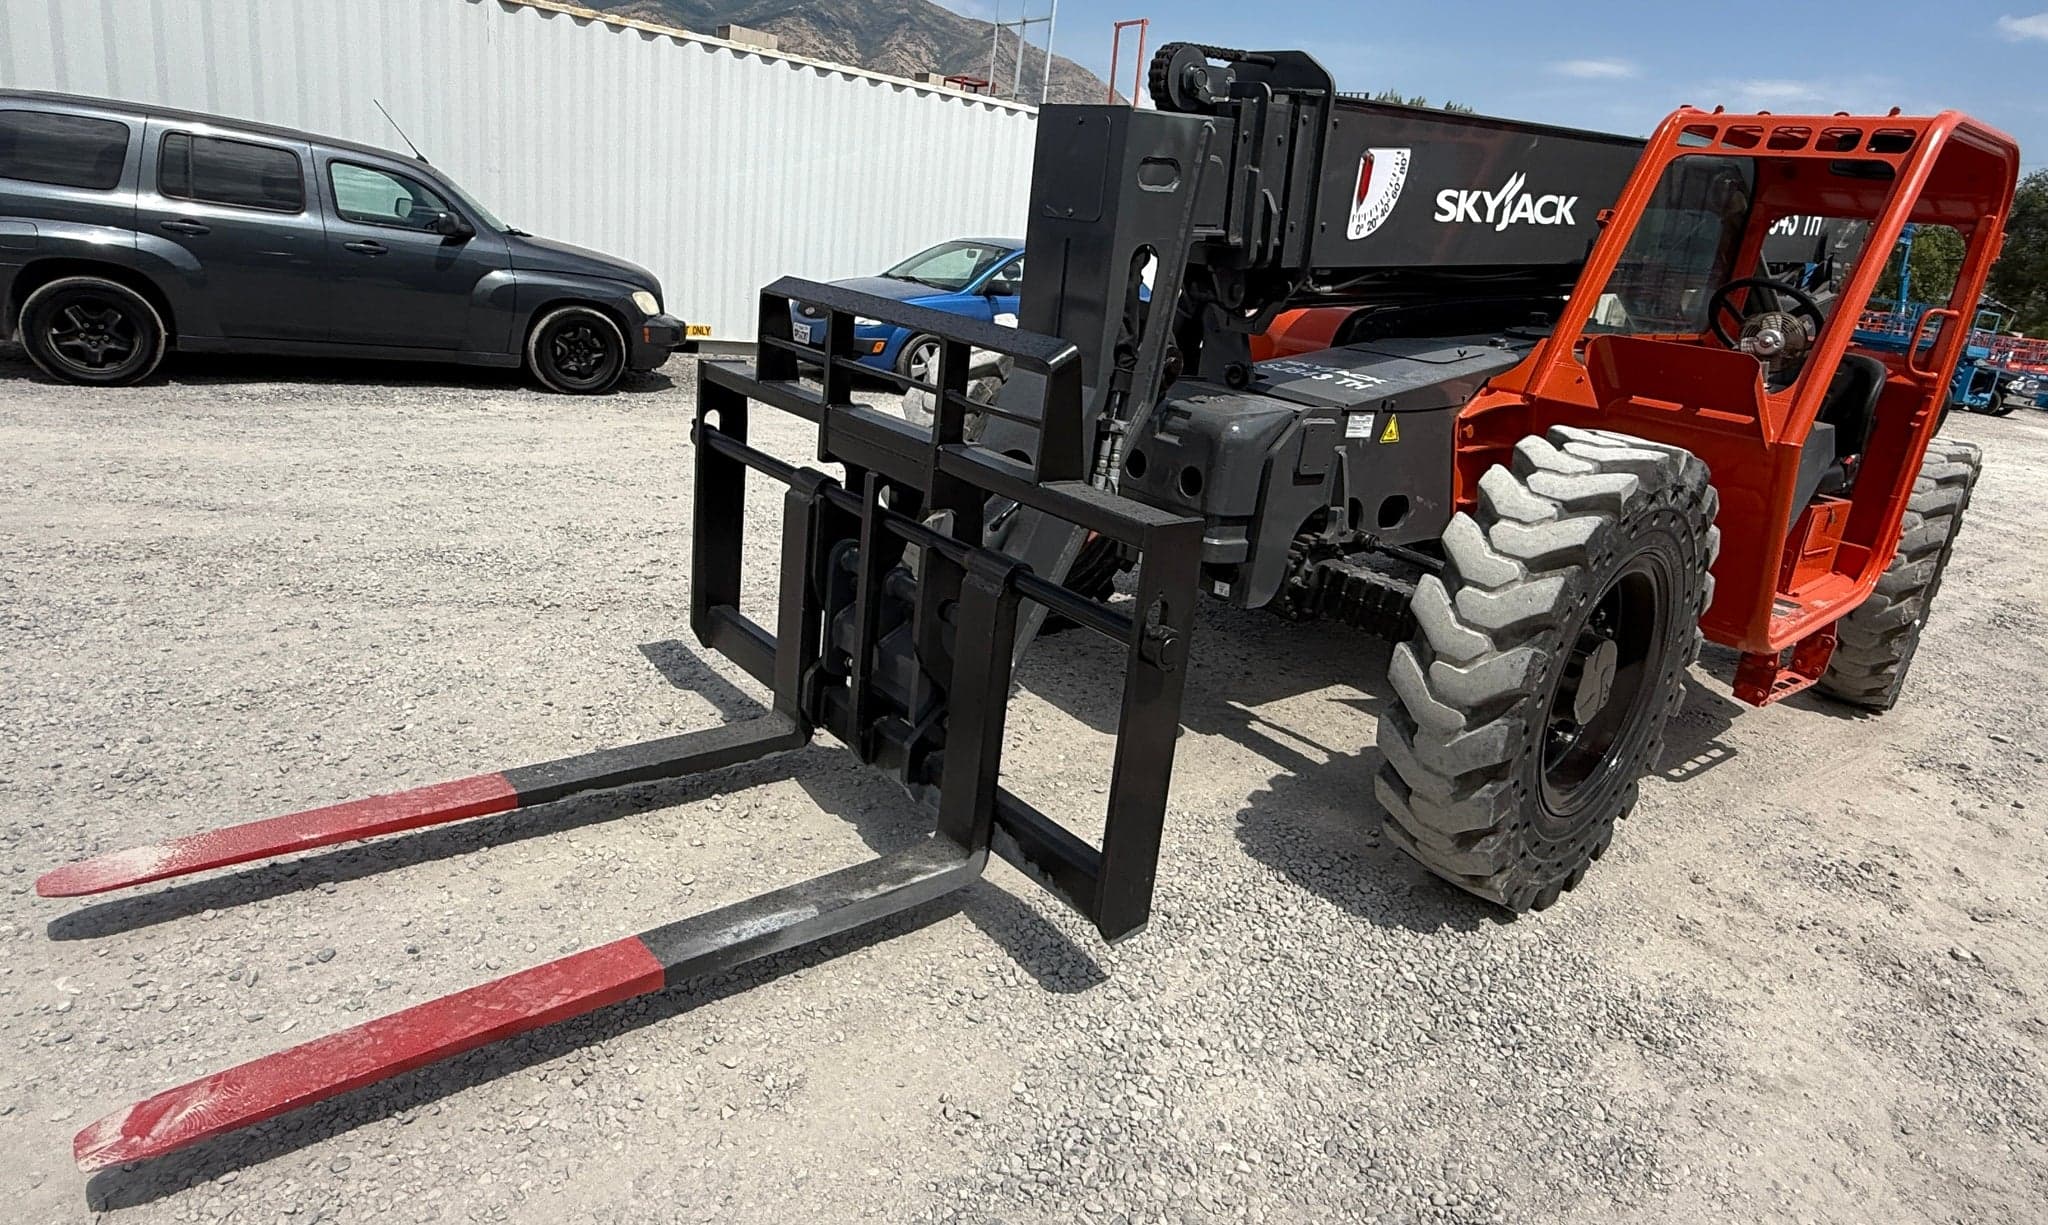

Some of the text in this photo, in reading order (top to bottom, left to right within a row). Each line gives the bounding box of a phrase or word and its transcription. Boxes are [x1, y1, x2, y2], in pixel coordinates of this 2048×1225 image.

[1434, 171, 1578, 231] SKYJACK
[692, 326, 711, 336] ONLY
[1335, 377, 1374, 390] TH
